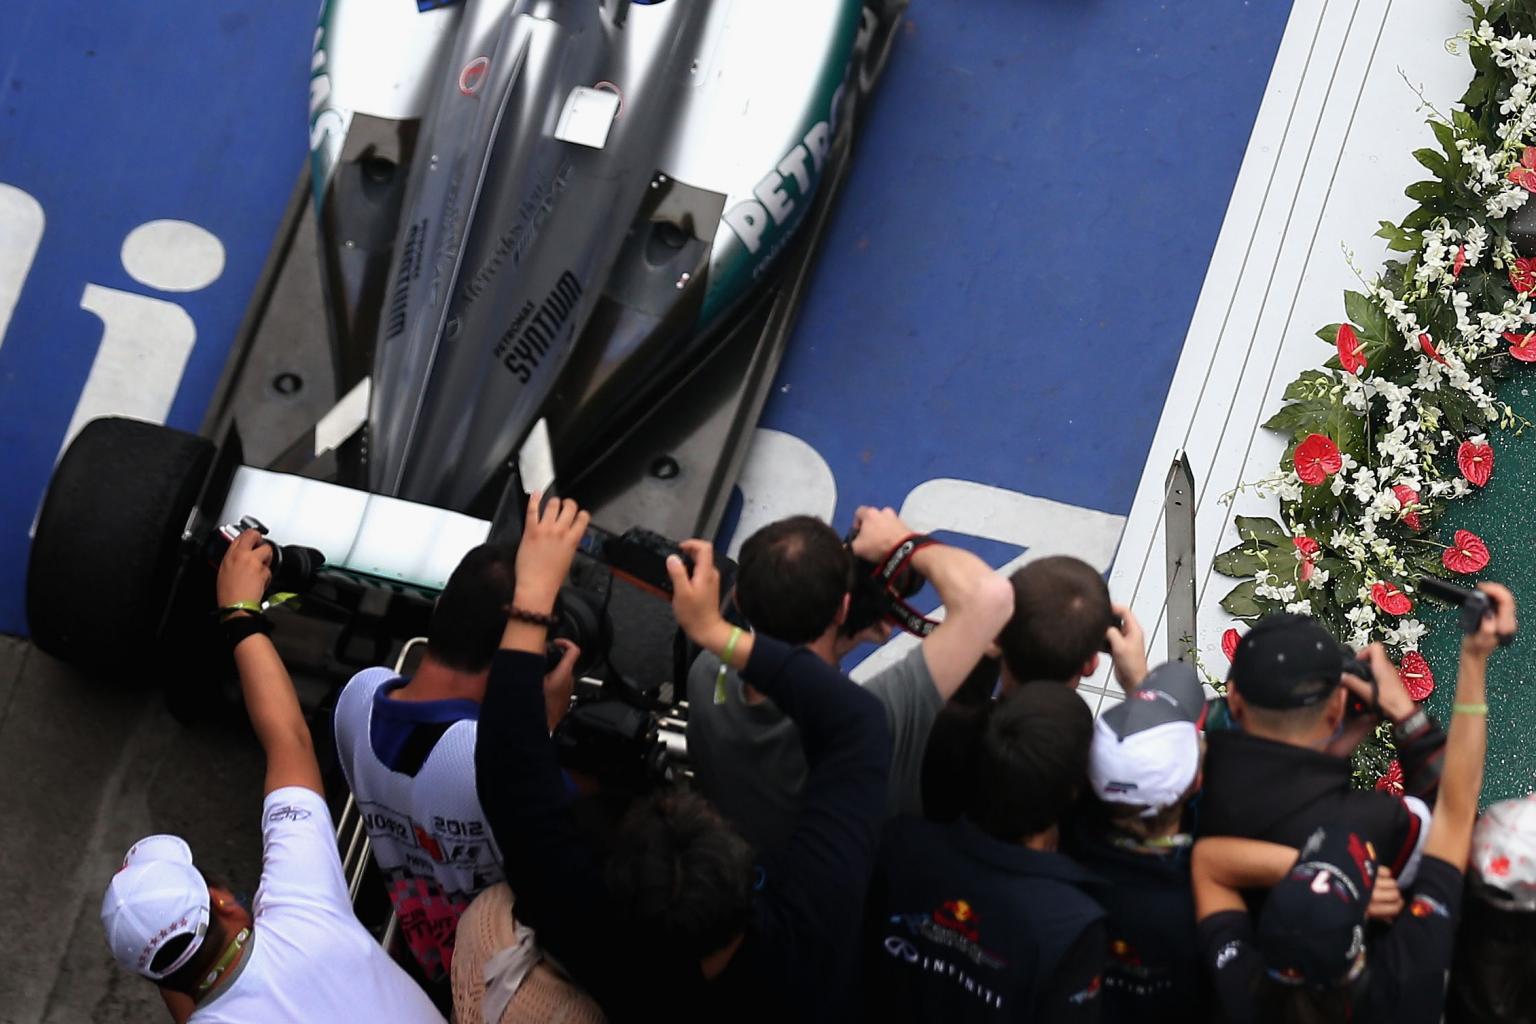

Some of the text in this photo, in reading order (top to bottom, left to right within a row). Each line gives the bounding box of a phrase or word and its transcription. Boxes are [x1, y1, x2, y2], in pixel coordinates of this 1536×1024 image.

[504, 270, 583, 384] SYNTIUM
[433, 816, 484, 837] 2012
[923, 957, 1001, 1009] INFINITI
